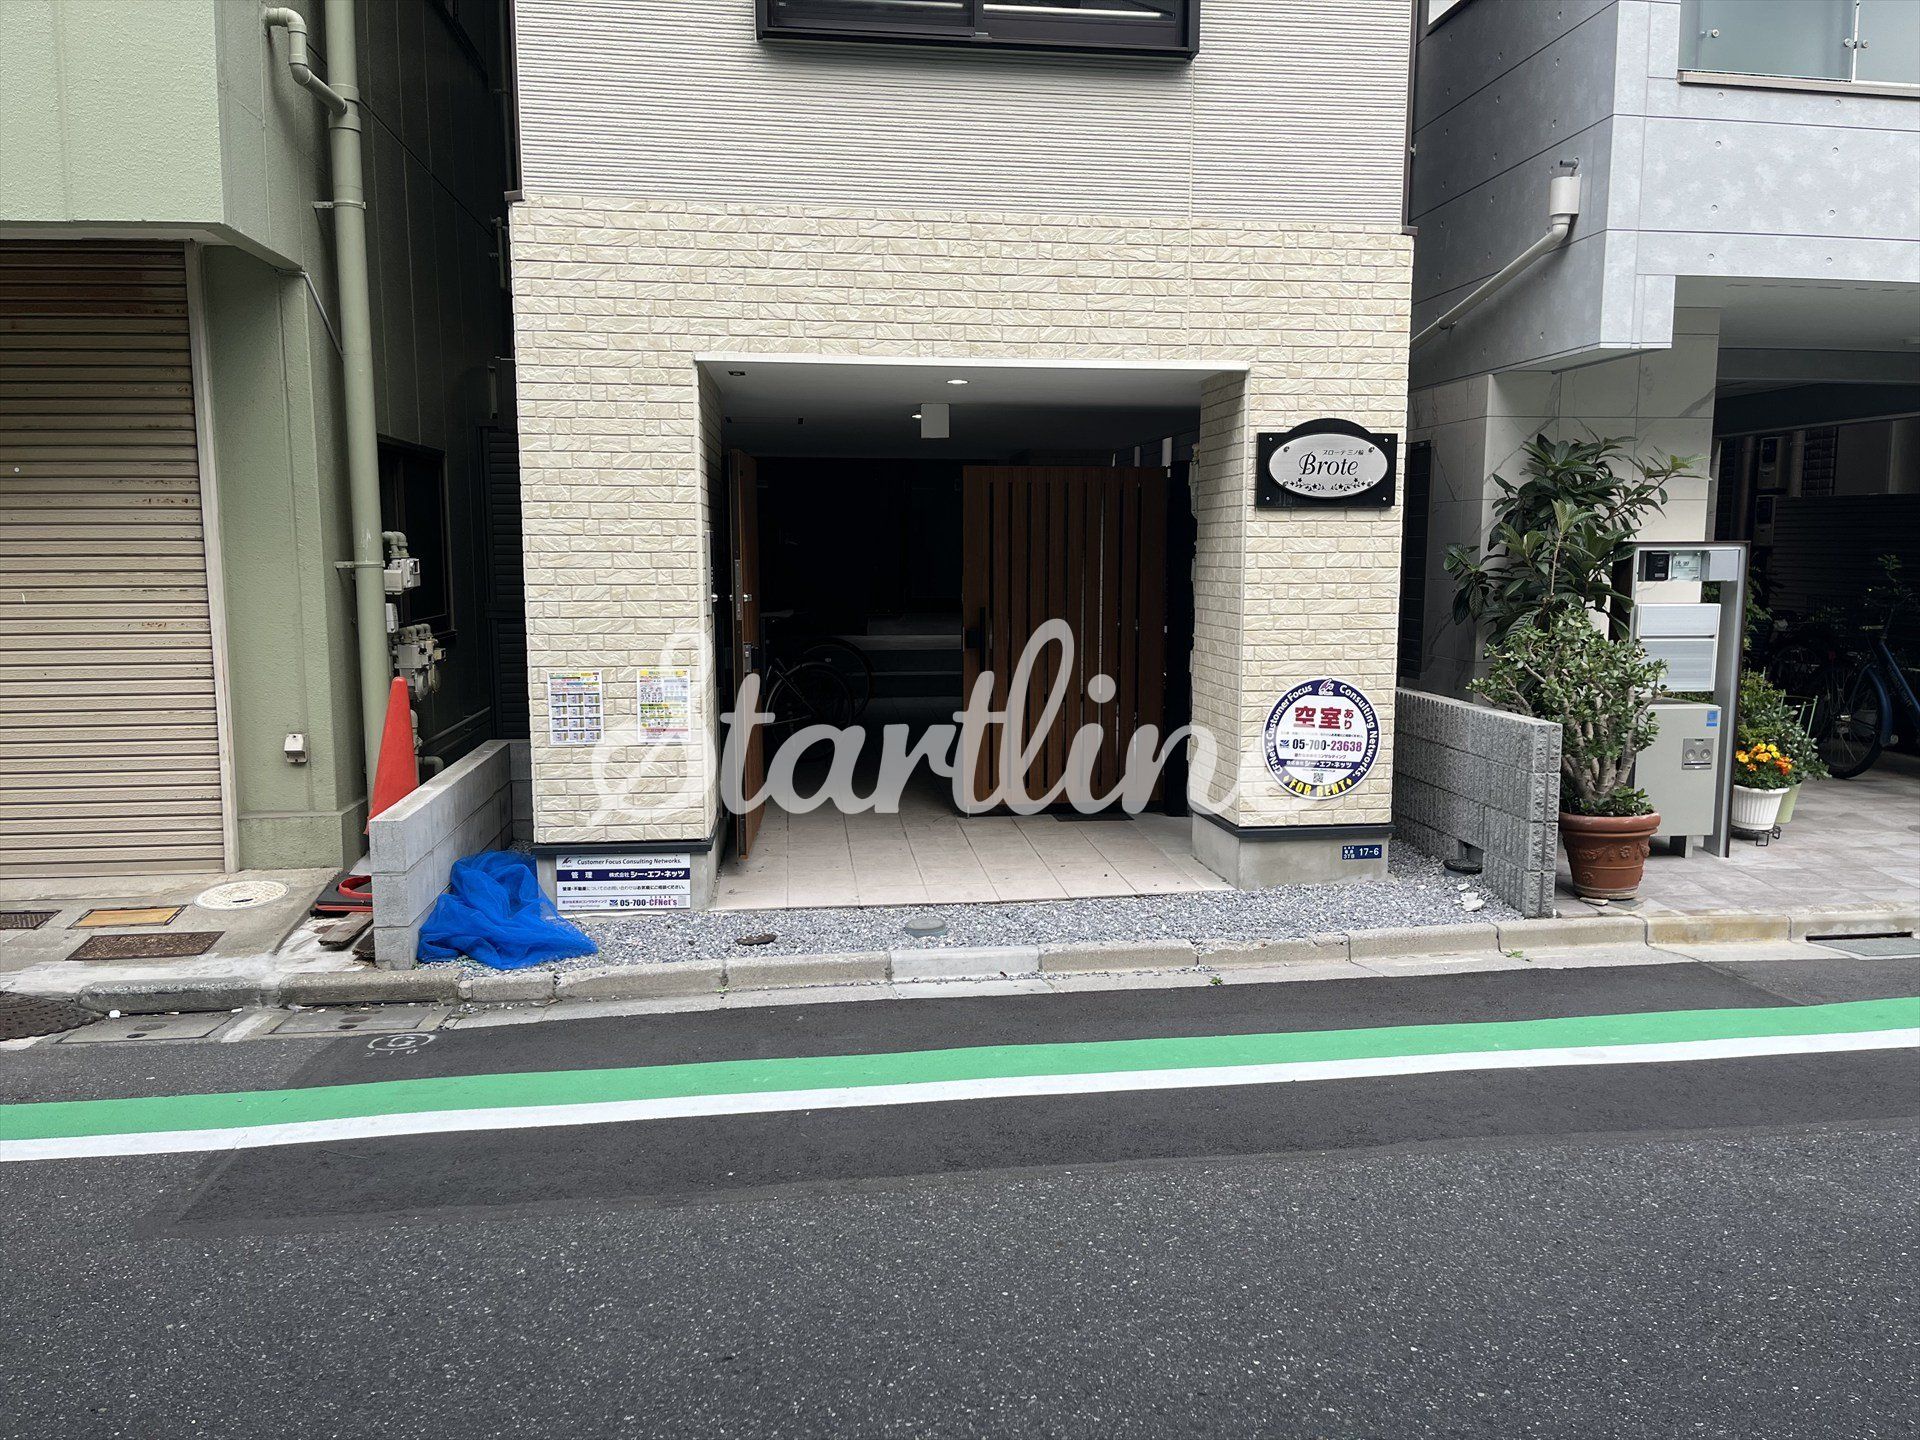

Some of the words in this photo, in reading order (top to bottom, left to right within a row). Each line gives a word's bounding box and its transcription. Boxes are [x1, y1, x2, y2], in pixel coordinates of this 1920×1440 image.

[1298, 451, 1359, 476] Brote
[1265, 700, 1290, 740] Customer
[1287, 684, 1313, 702] Focus
[1339, 684, 1376, 729] Consulting
[1293, 706, 1342, 730] 空室
[1344, 709, 1354, 730] あり
[1292, 738, 1362, 752] 05-700-23638
[1288, 779, 1312, 796] FOR
[1316, 780, 1347, 796] RENT
[1359, 847, 1379, 856] 17-6
[622, 858, 653, 866] Consulting
